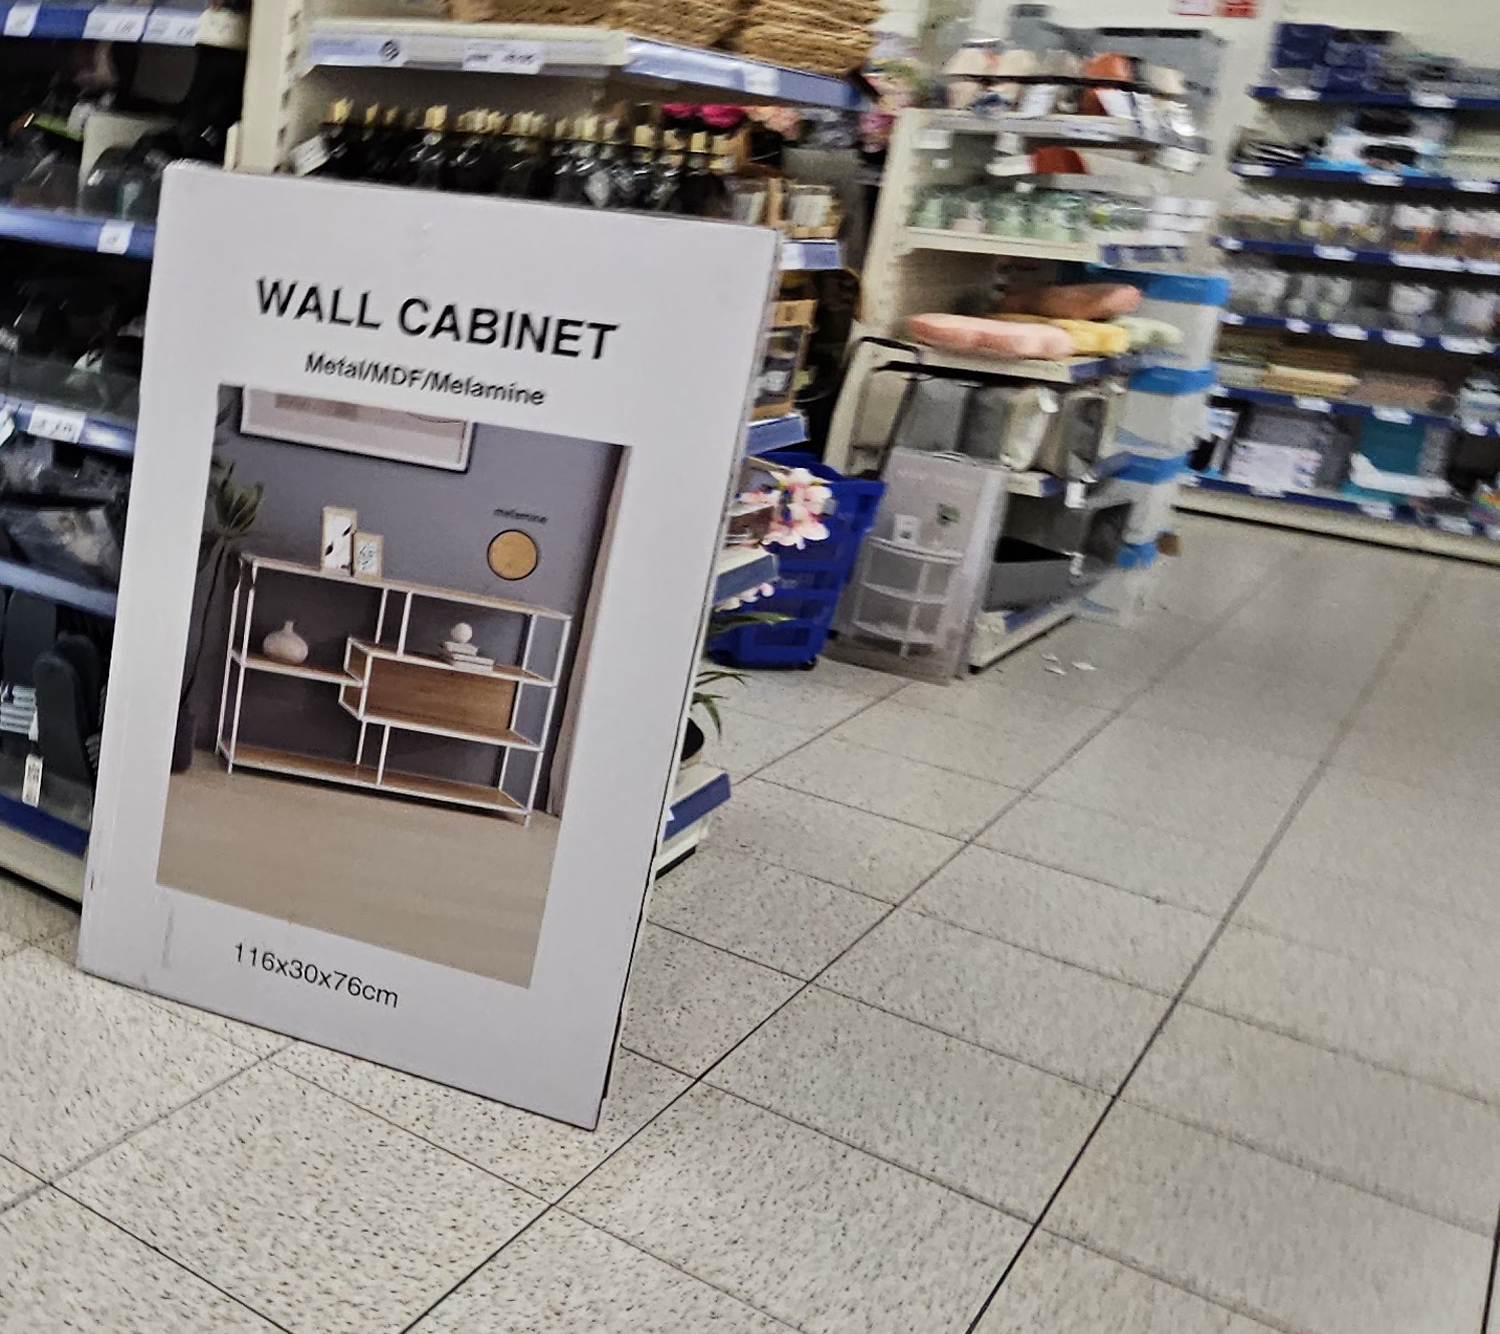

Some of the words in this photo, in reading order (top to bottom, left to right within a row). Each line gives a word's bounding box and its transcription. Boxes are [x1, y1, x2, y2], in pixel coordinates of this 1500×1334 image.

[256, 276, 382, 330] WALL
[398, 297, 619, 360] CABINET
[304, 352, 546, 406] Metal/MDF/Melamine
[235, 941, 399, 1009] 116x30x76cm
